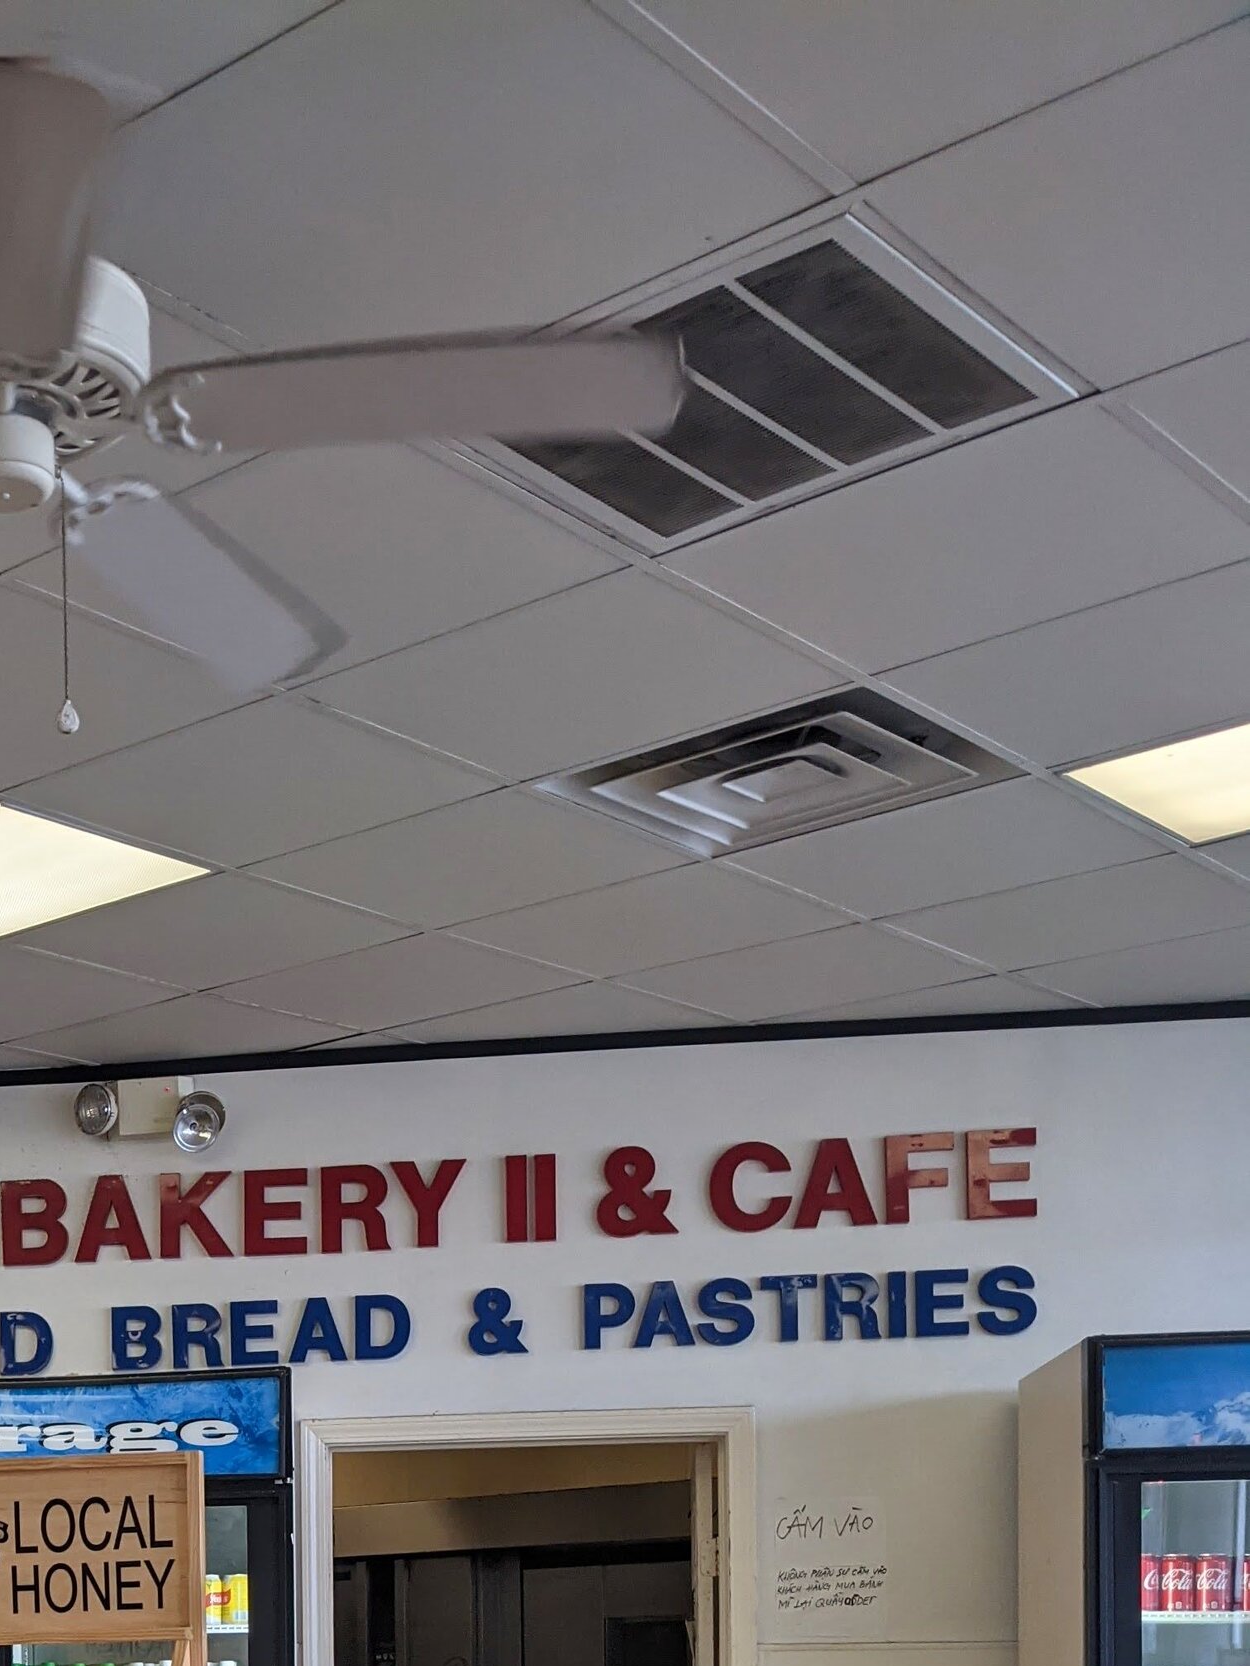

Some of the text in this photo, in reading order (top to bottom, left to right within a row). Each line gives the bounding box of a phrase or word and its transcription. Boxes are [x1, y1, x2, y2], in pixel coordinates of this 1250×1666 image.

[504, 1153, 556, 1243] II
[595, 1144, 678, 1239] &
[708, 1127, 1037, 1232] CAFE
[112, 1293, 410, 1371] BREAD
[466, 1287, 528, 1356] &
[582, 1265, 1037, 1351] PASTRIES
[13, 1495, 174, 1554] LOCAL
[11, 1559, 175, 1614] HONEY
